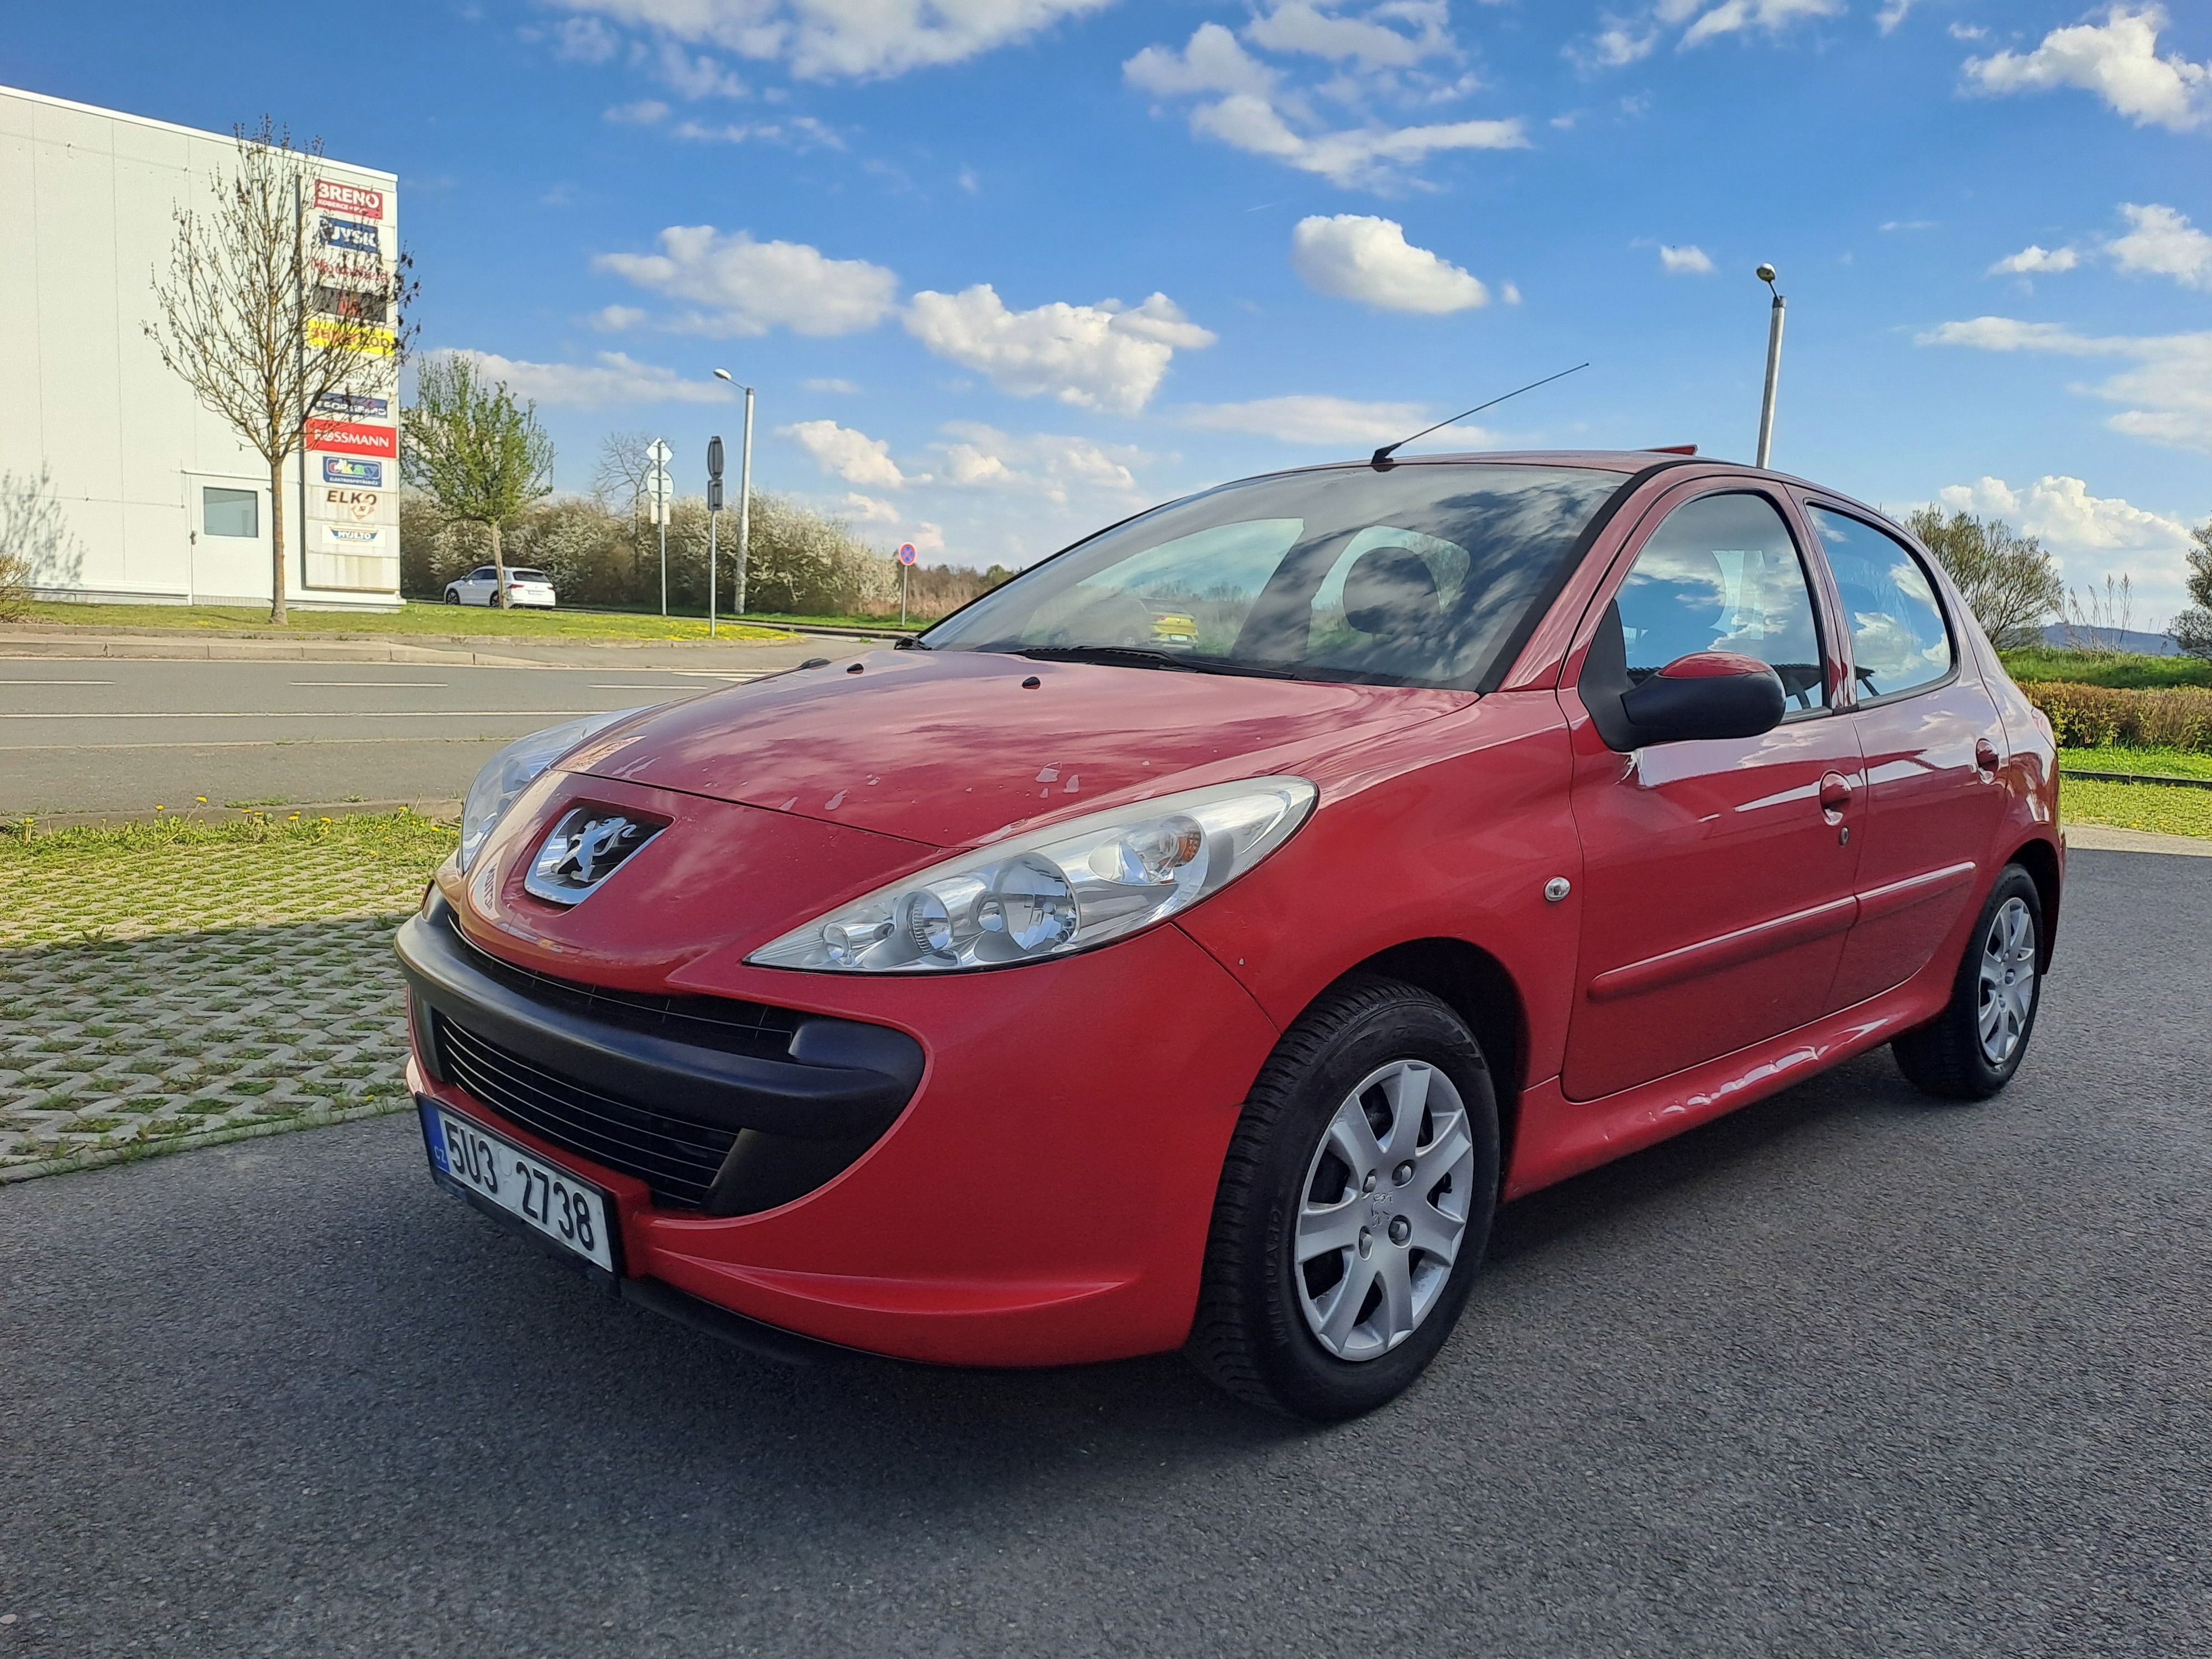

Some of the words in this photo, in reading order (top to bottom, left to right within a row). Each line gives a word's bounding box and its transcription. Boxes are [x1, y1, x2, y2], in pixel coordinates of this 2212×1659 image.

[314, 429, 389, 448] ROSSMANN
[434, 1146, 447, 1164] CZ
[444, 1120, 498, 1193] 5U3
[516, 1160, 594, 1251] 2738
